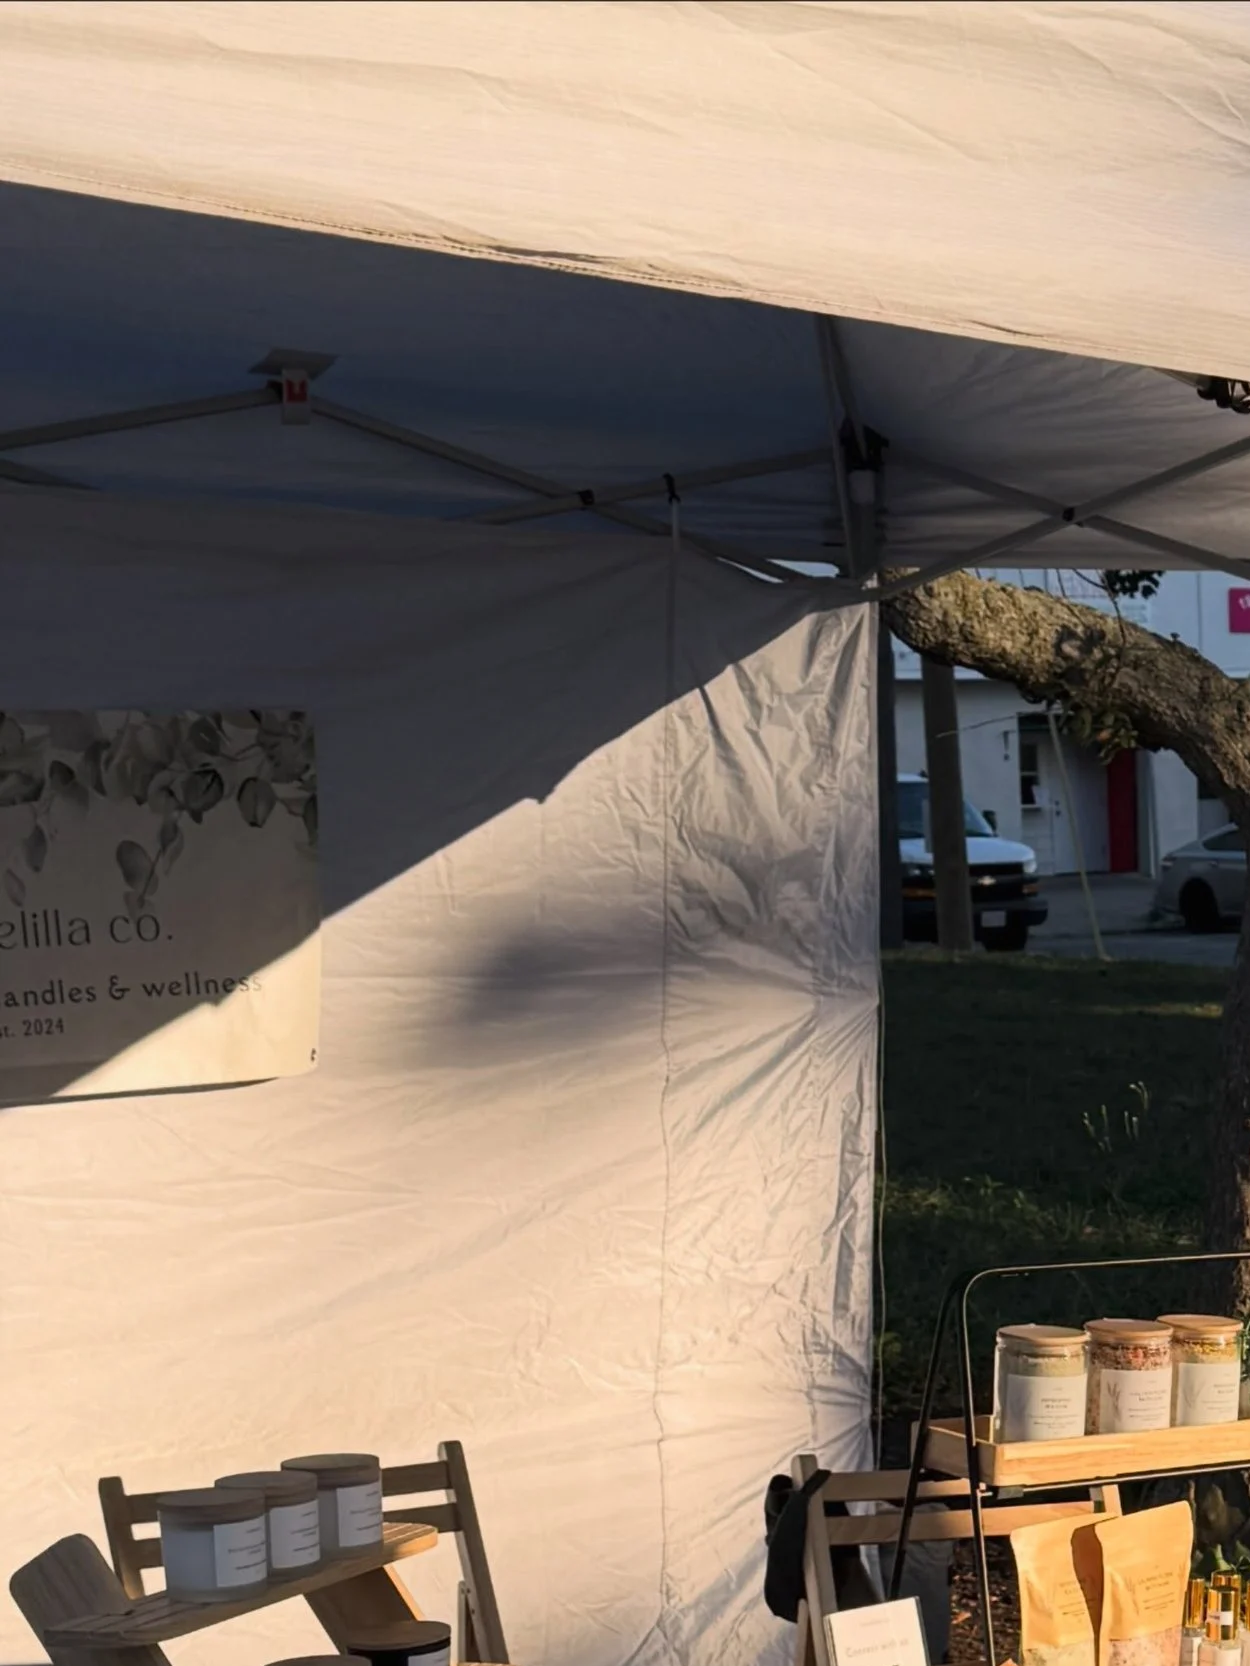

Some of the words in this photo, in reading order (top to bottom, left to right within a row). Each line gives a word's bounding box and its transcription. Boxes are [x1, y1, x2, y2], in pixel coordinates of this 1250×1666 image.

[109, 913, 174, 944] co.
[108, 975, 131, 1001] &
[142, 971, 263, 998] wellness
[22, 1017, 65, 1037] 2024
